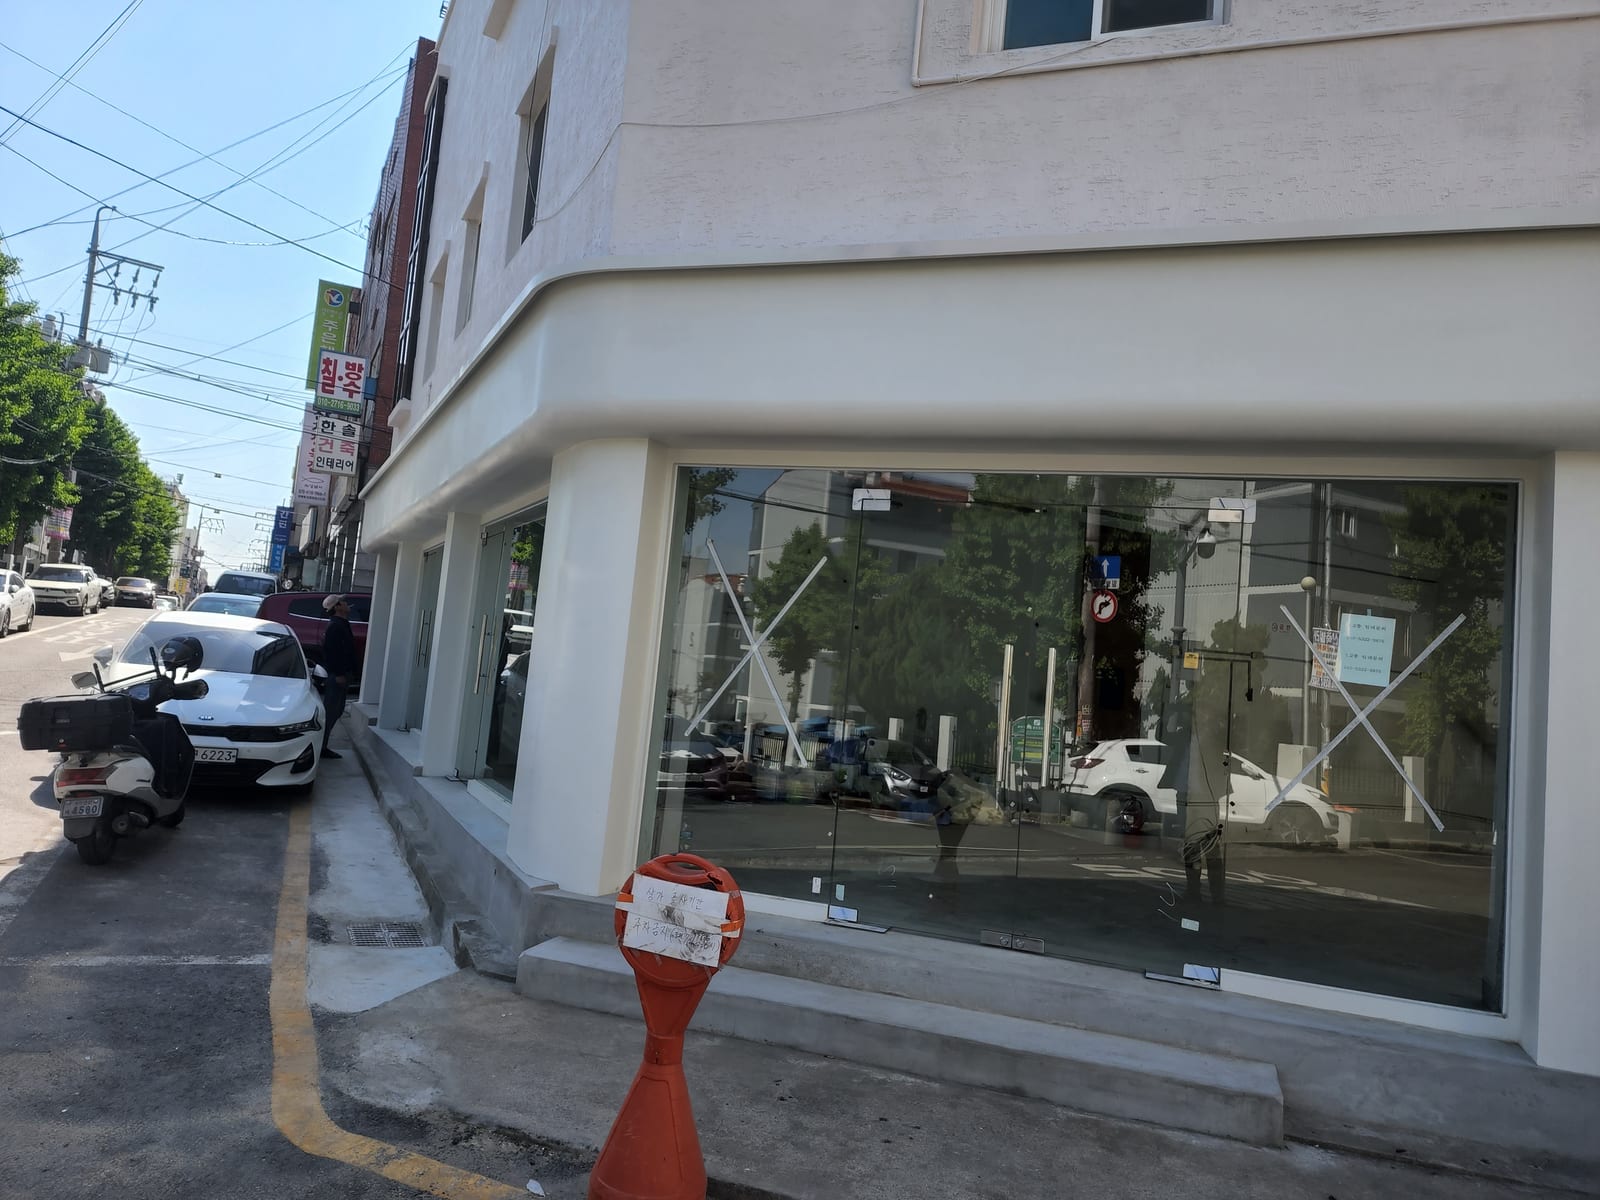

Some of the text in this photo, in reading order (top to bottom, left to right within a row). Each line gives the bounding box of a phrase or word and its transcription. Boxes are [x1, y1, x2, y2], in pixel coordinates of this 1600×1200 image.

[316, 456, 354, 472] 인테리어
[200, 750, 232, 761] 6223
[646, 887, 664, 902] 상가
